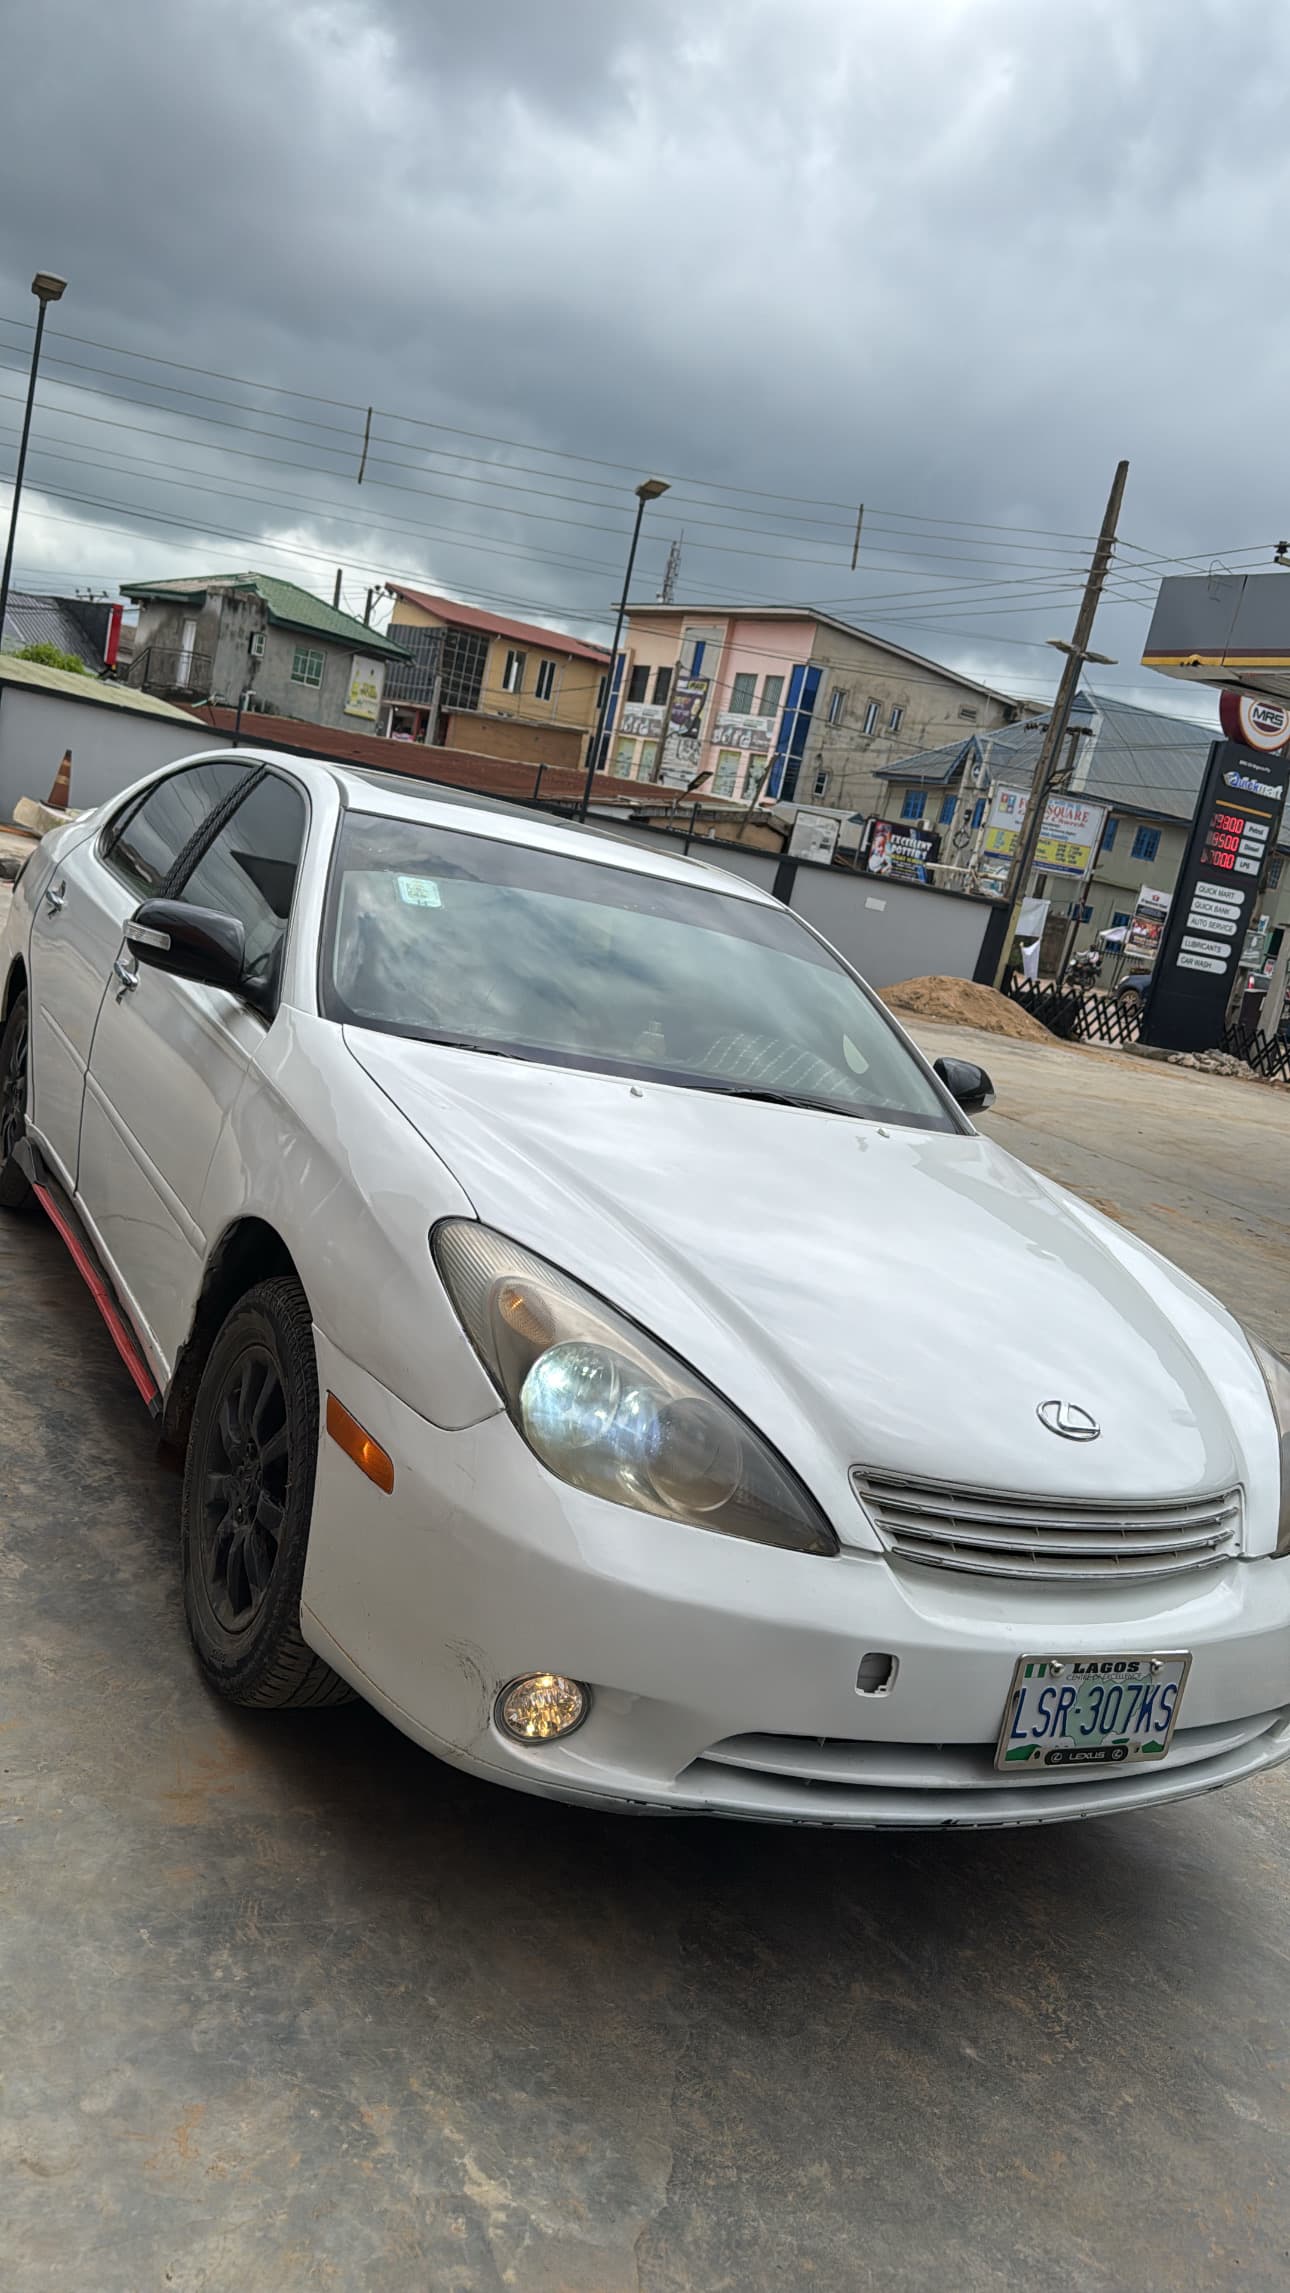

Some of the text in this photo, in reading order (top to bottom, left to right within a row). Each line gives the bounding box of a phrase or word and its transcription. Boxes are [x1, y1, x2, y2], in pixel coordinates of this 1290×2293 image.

[1252, 706, 1284, 727] MRS
[1198, 885, 1235, 899] QUICK MART
[1194, 900, 1231, 915] QUICK BANK
[1190, 918, 1234, 932] AUTO SERVICE
[1184, 939, 1222, 953] LUBRICANTS
[1180, 956, 1213, 969] CAR WASH
[1071, 1661, 1141, 1674] LAGOS
[1068, 1751, 1106, 1761] LEXUS
